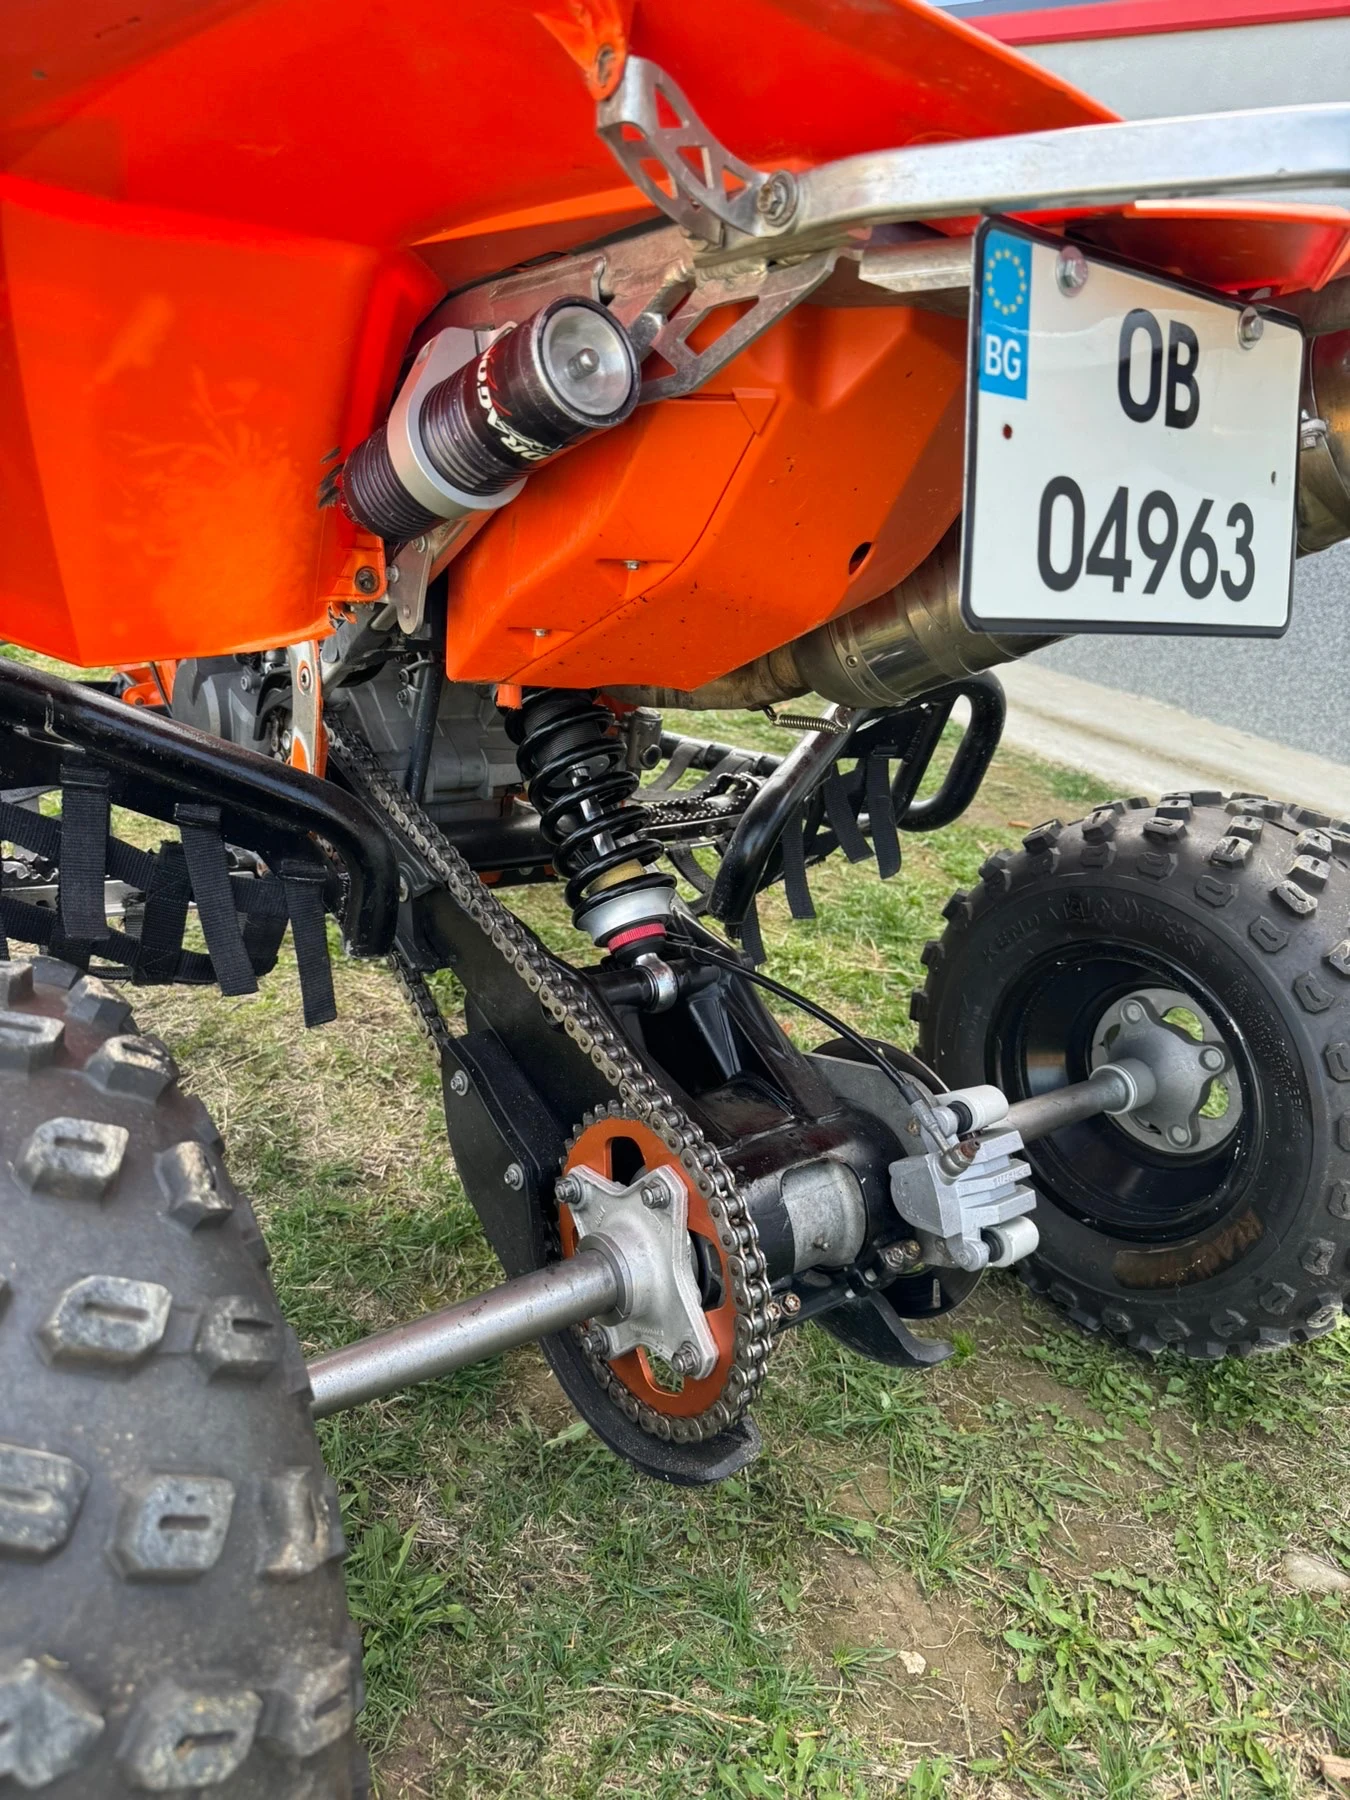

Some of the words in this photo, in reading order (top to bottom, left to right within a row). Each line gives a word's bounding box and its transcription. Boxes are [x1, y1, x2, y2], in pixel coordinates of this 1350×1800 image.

[984, 334, 1022, 380] BG
[1117, 308, 1200, 429] OB
[1037, 475, 1255, 601] 04963
